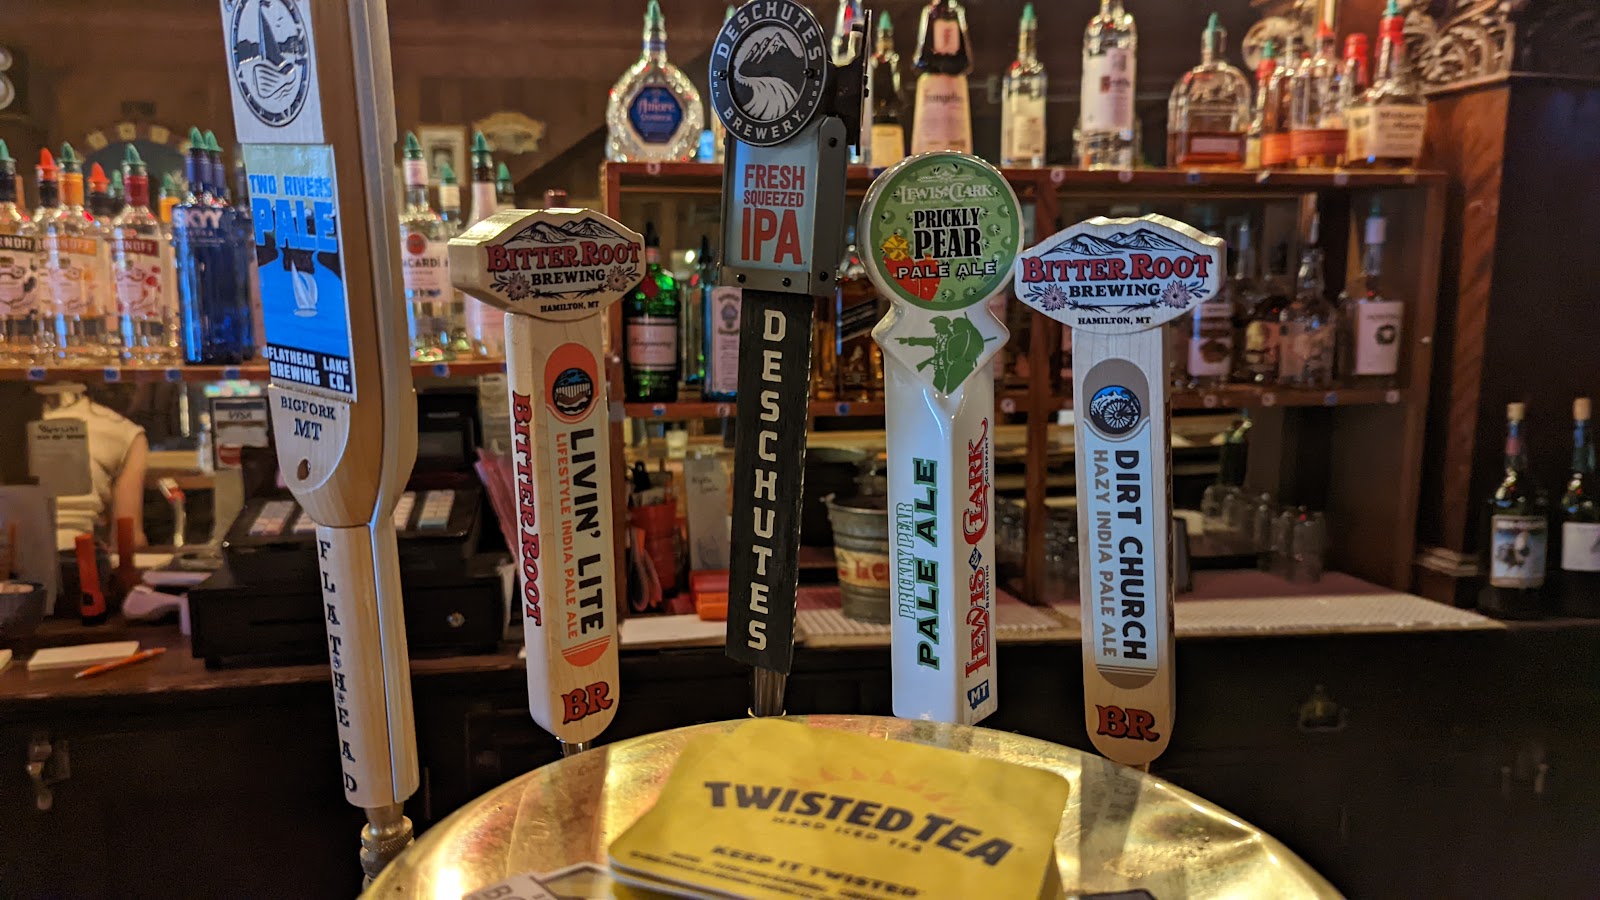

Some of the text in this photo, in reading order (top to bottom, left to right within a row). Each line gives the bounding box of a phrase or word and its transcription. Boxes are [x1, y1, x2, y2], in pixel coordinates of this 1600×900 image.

[717, 1, 823, 61] DESCHUTES
[808, 70, 820, 107] 1988
[723, 107, 804, 140] BREWERY
[248, 174, 332, 197] TWO RIVERS
[744, 164, 806, 190] FRESH
[898, 185, 945, 205] LEWIS
[949, 182, 994, 203] CLARK
[743, 190, 804, 208] SQUEEZED
[251, 197, 338, 253] PALE
[913, 207, 981, 229] PRICKLY
[741, 207, 803, 265] IPA
[913, 227, 982, 260] PEAR
[485, 241, 642, 272] BITTER ROOT
[897, 261, 997, 279] PALE ALE
[1021, 254, 1213, 283] BITTER ROOT
[531, 269, 607, 286] BREWING
[1069, 283, 1161, 298] BREWING
[540, 301, 600, 313] HAMILTON, MT
[1078, 316, 1151, 326] HAMILTON, MT
[267, 346, 350, 375] FLATHEAD LAKE
[269, 361, 351, 392] BREWING CO.
[280, 396, 336, 420] BIGFORK
[294, 418, 322, 440] MT
[748, 309, 787, 651] DESCHUTES
[962, 417, 989, 545] CLARK
[513, 390, 541, 626] BITTER ROOT
[556, 432, 578, 640] LIFESTYLE INDIA PALE ALE
[570, 428, 604, 635] LIVIN' LITE
[896, 502, 916, 620] PRICKLY PEAR
[912, 457, 941, 670] PALE ALE
[1093, 449, 1117, 658] HAZY INDIA PALE ALE
[1115, 450, 1147, 660] DIRT CHURCH
[965, 566, 990, 678] LEWIS
[318, 539, 359, 792] FLATHEAD
[561, 681, 614, 724] BR
[969, 682, 988, 704] MT
[1095, 704, 1161, 742] BR
[704, 781, 1014, 867] TWISTED TEA
[712, 845, 775, 863] KEEP
[810, 865, 918, 897] TWISTED
